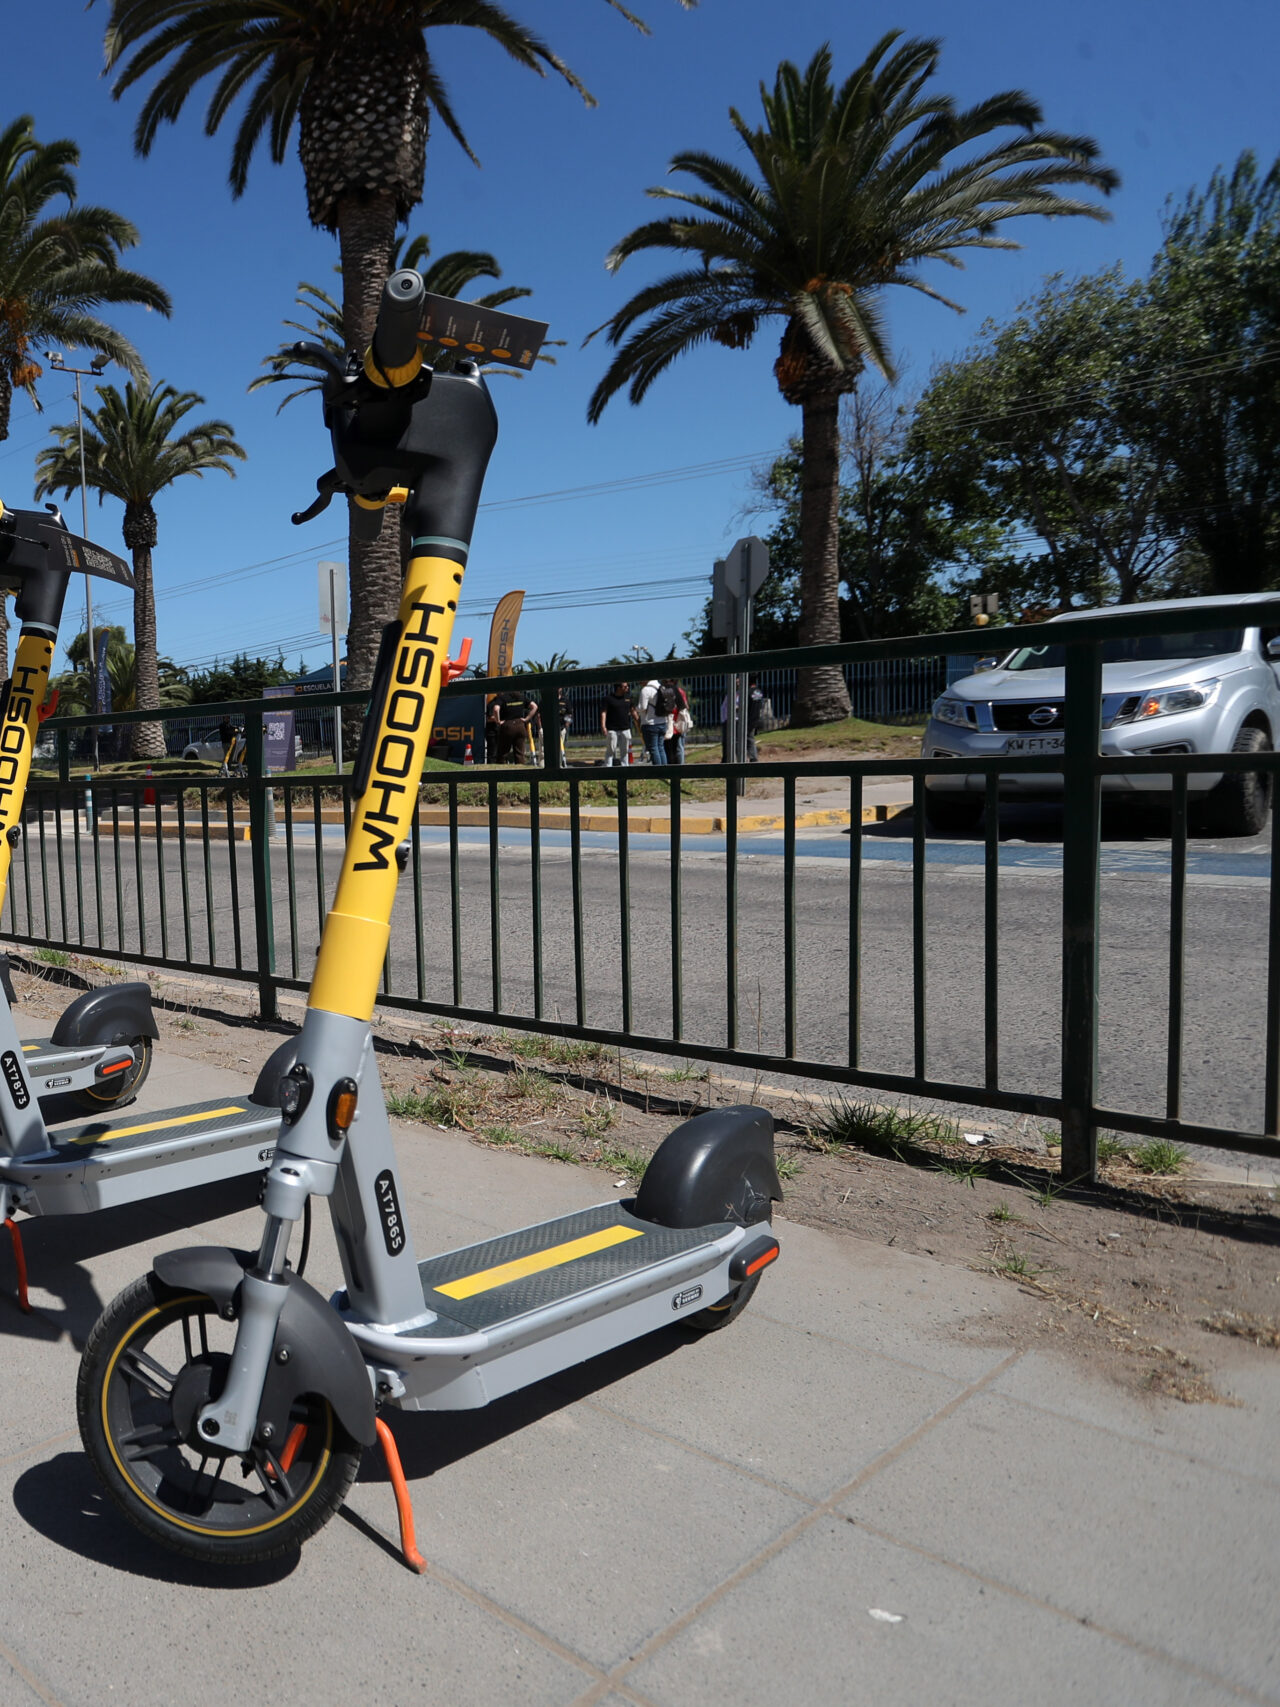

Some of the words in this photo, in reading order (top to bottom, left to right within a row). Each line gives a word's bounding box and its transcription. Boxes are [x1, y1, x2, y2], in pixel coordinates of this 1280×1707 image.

[497, 619, 510, 677] HOOSH
[303, 683, 330, 692] ESCUELA
[353, 602, 445, 871] WHOOSH
[433, 726, 474, 741] OSH
[4, 1057, 27, 1105] AT7873
[379, 1180, 402, 1249] AT7865
